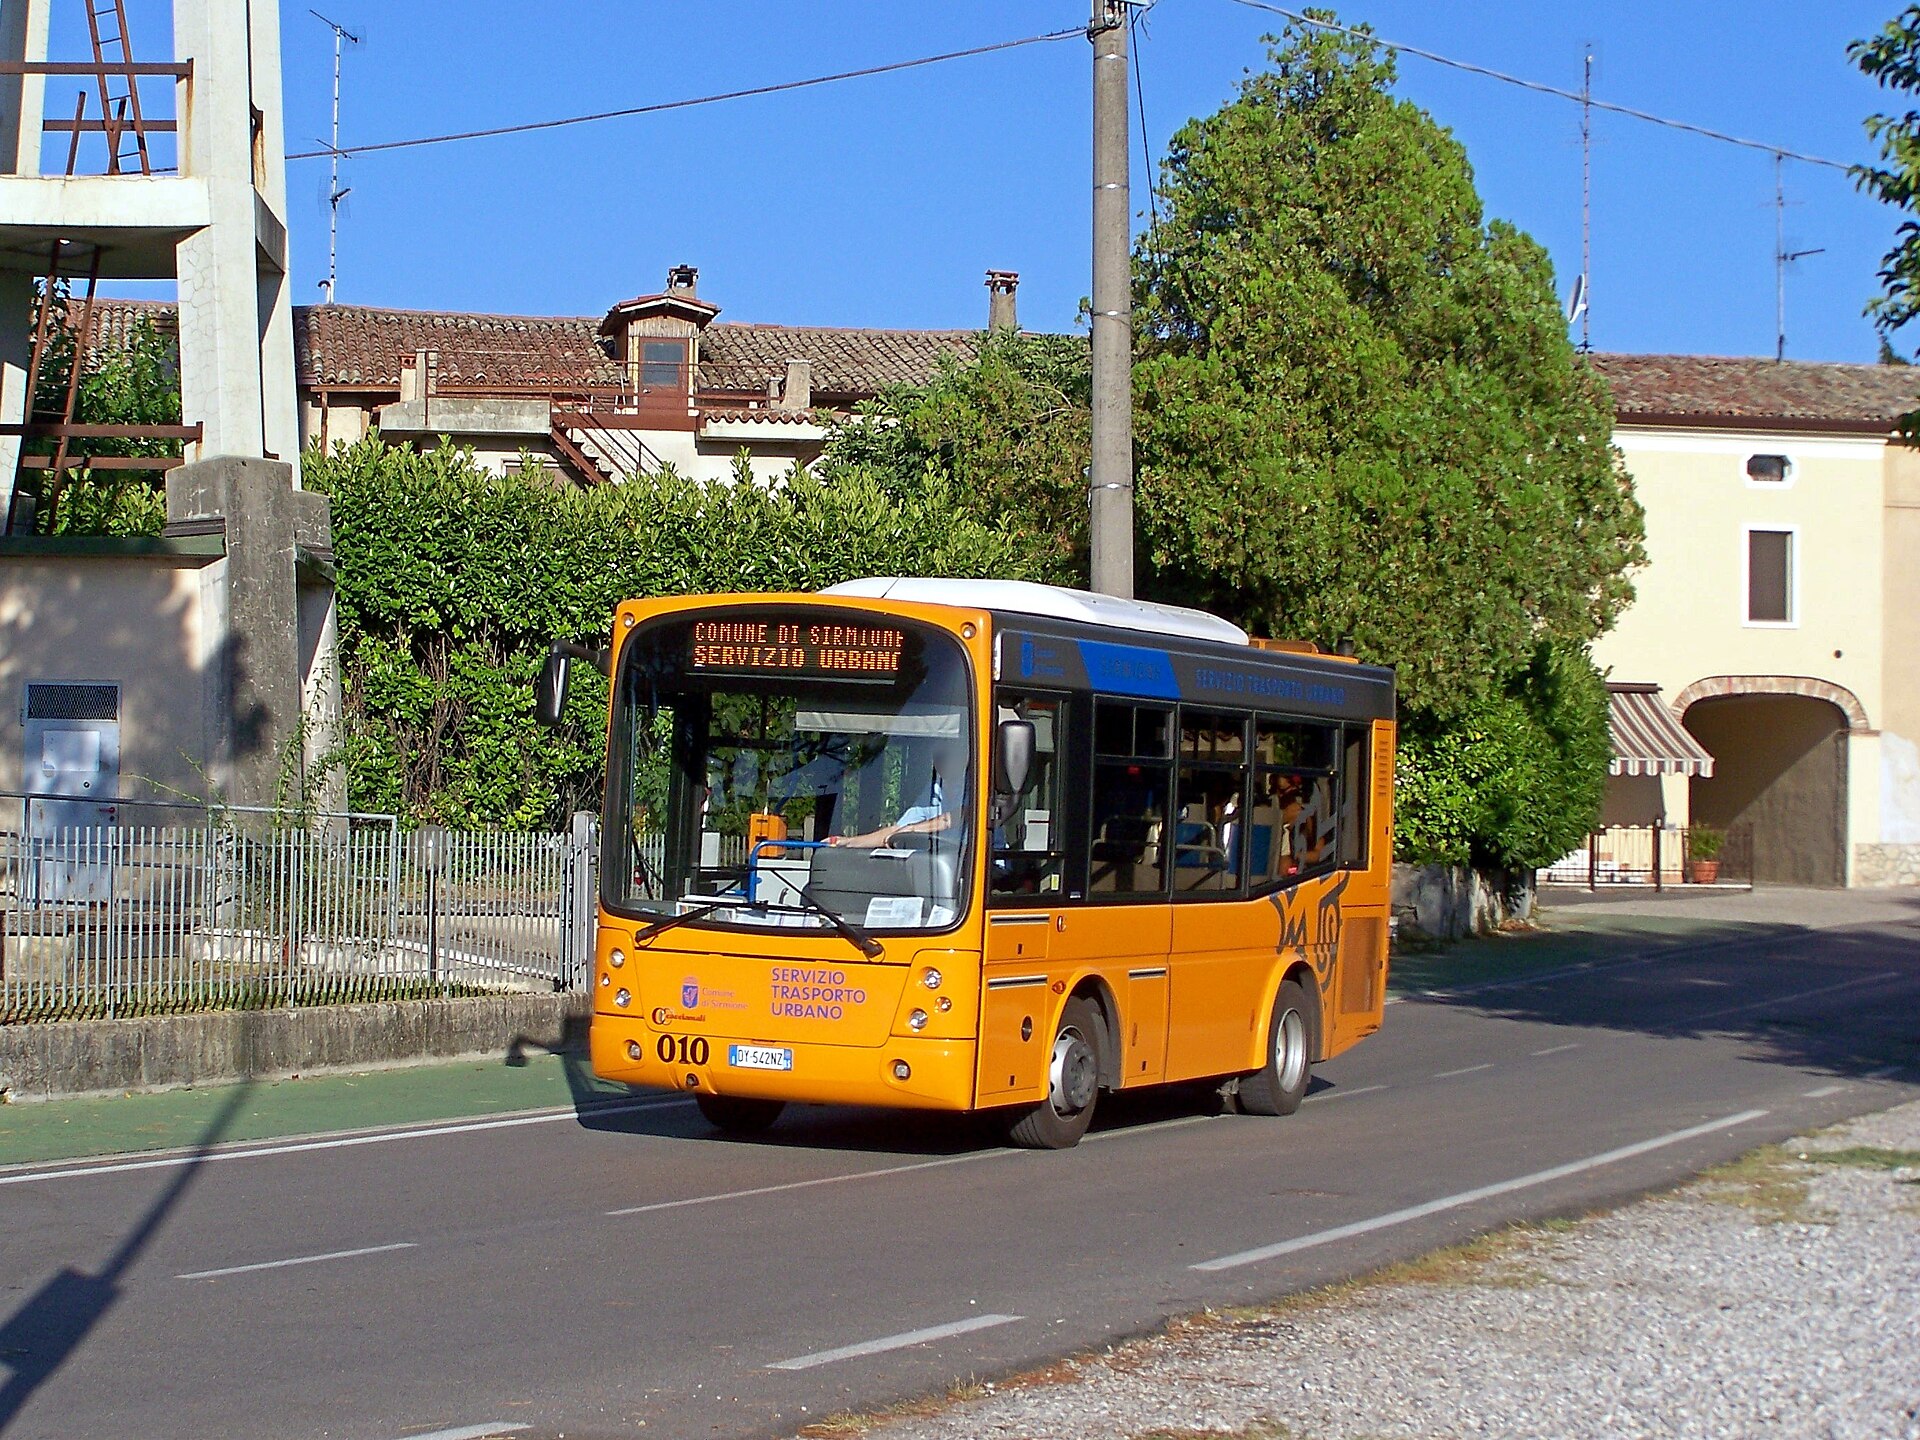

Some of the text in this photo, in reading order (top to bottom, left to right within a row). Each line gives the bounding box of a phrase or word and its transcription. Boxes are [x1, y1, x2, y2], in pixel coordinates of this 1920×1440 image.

[696, 622, 767, 643] COMUNE
[779, 624, 799, 644] DI
[694, 646, 805, 668] SERVIZIO
[772, 967, 845, 985] SERVIZIO
[771, 985, 866, 1004] TRASPORTO
[772, 1002, 842, 1020] URBANO
[657, 1034, 709, 1066] 010
